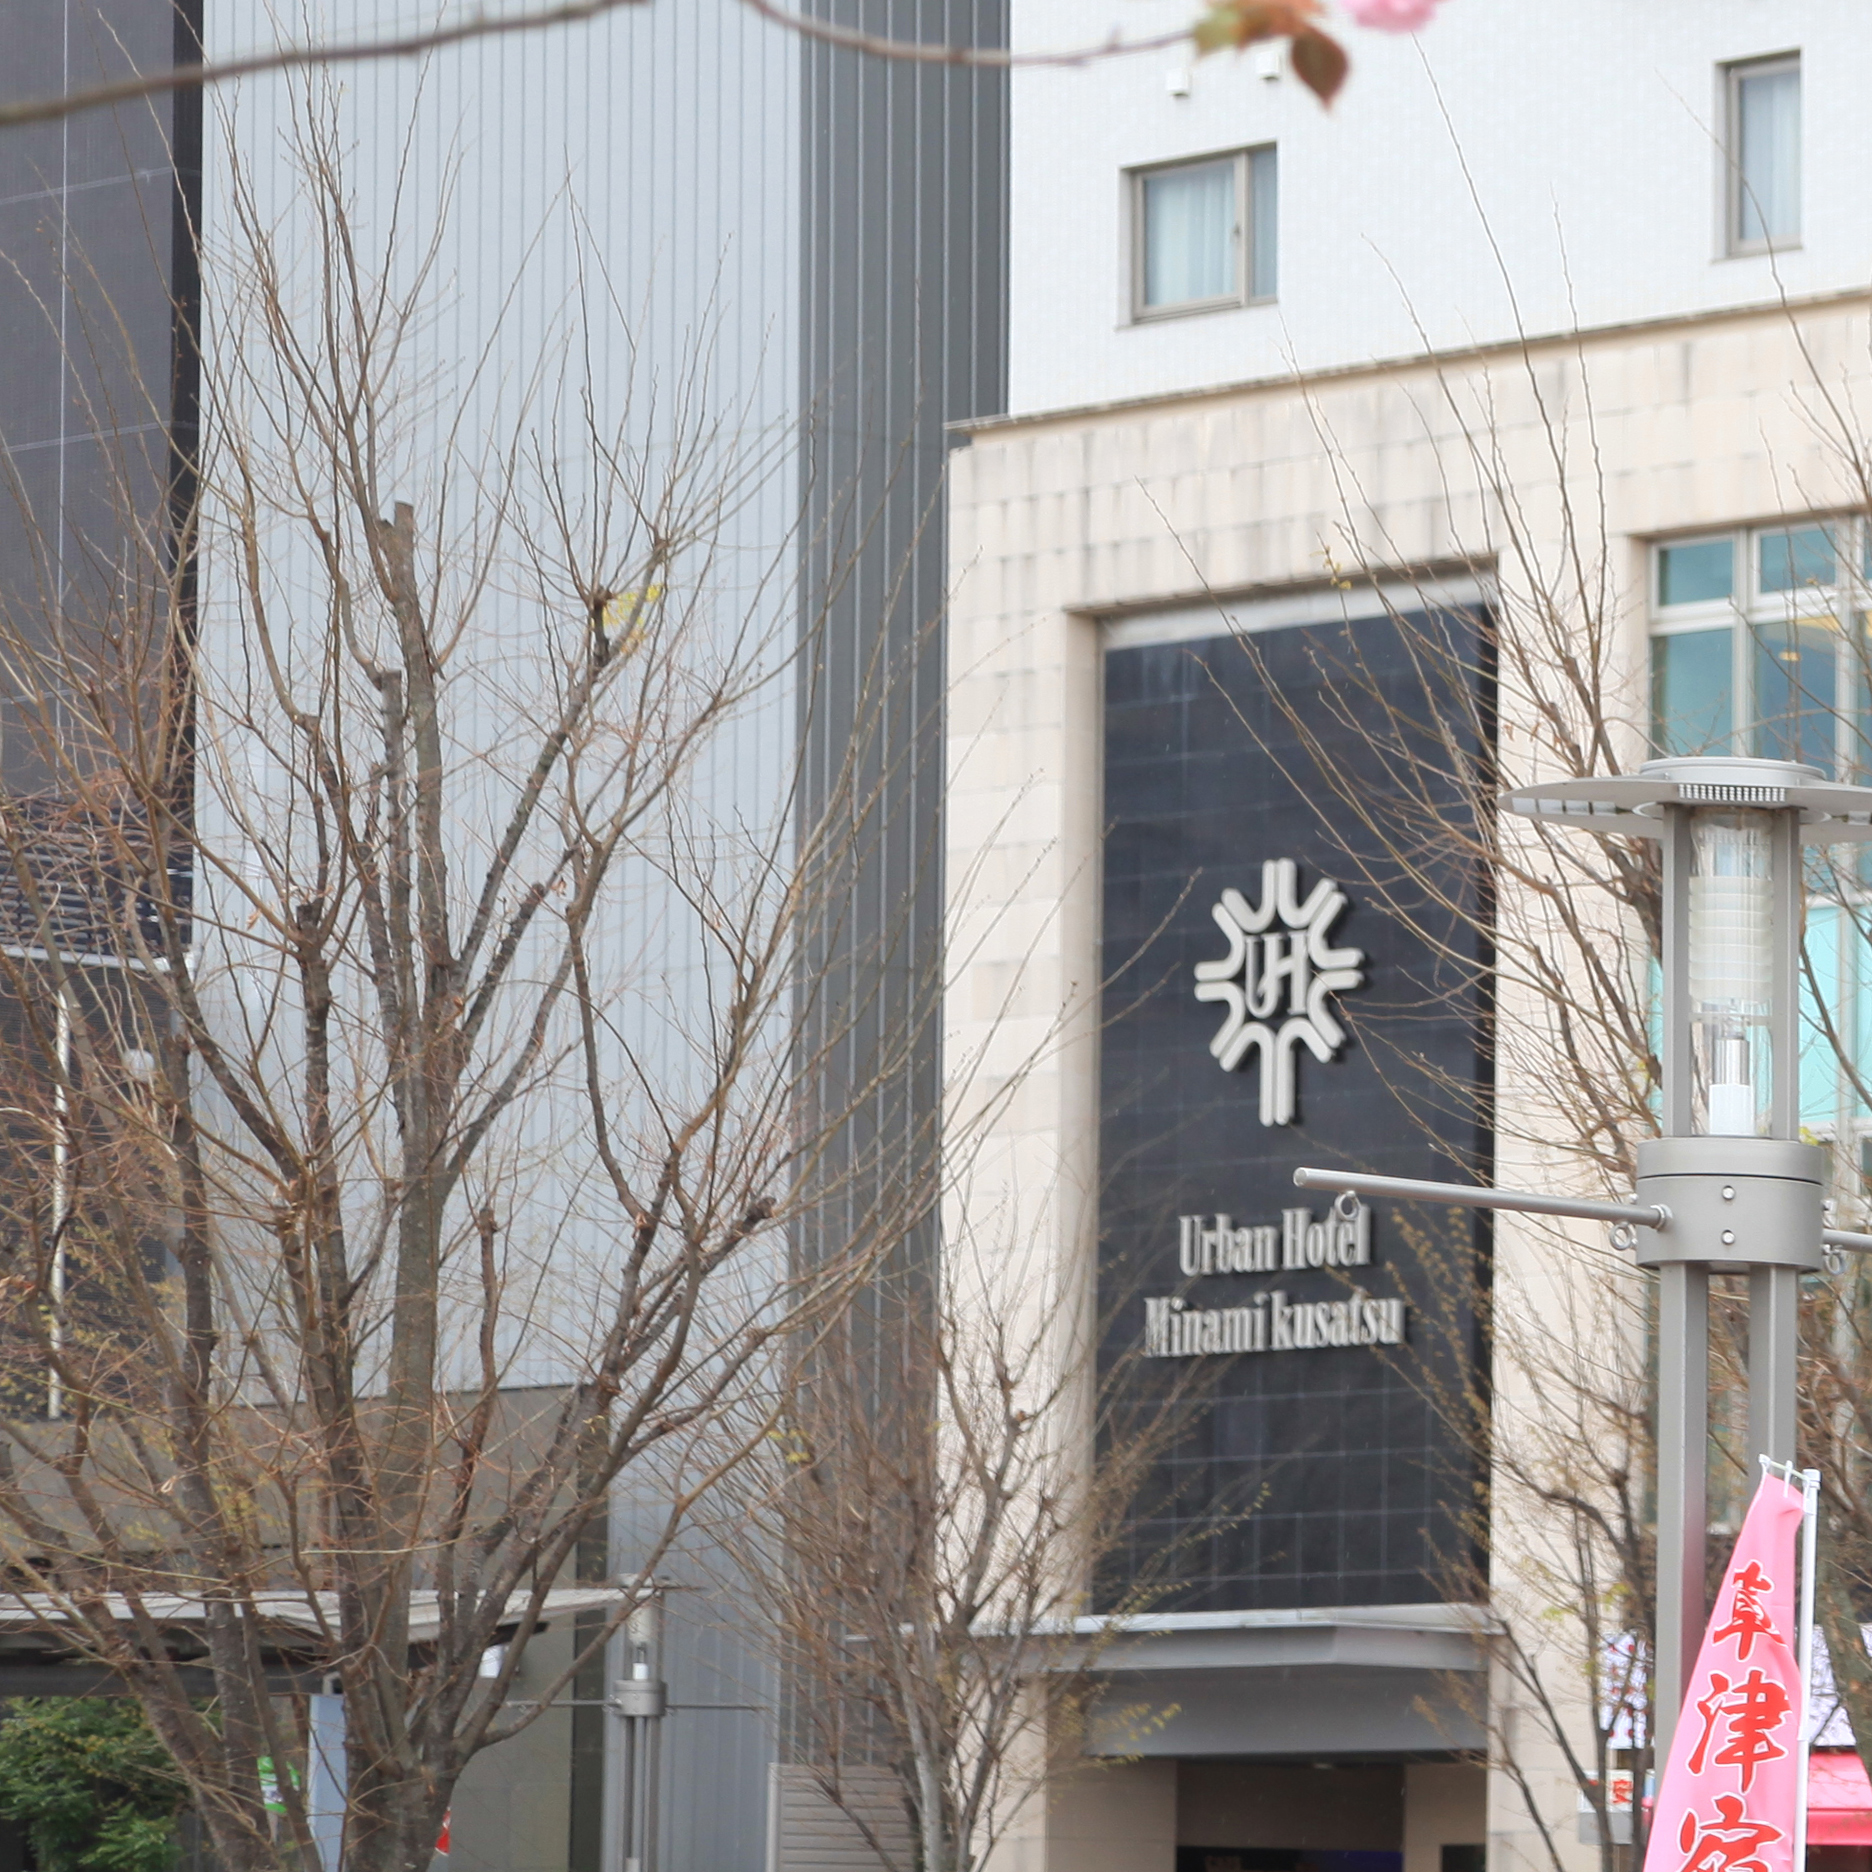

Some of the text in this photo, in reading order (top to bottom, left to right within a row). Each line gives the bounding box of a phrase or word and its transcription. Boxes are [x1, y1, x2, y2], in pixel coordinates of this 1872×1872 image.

[1178, 1206, 1372, 1277] Urban Hotel
[1143, 1286, 1407, 1359] Minami kusatsu
